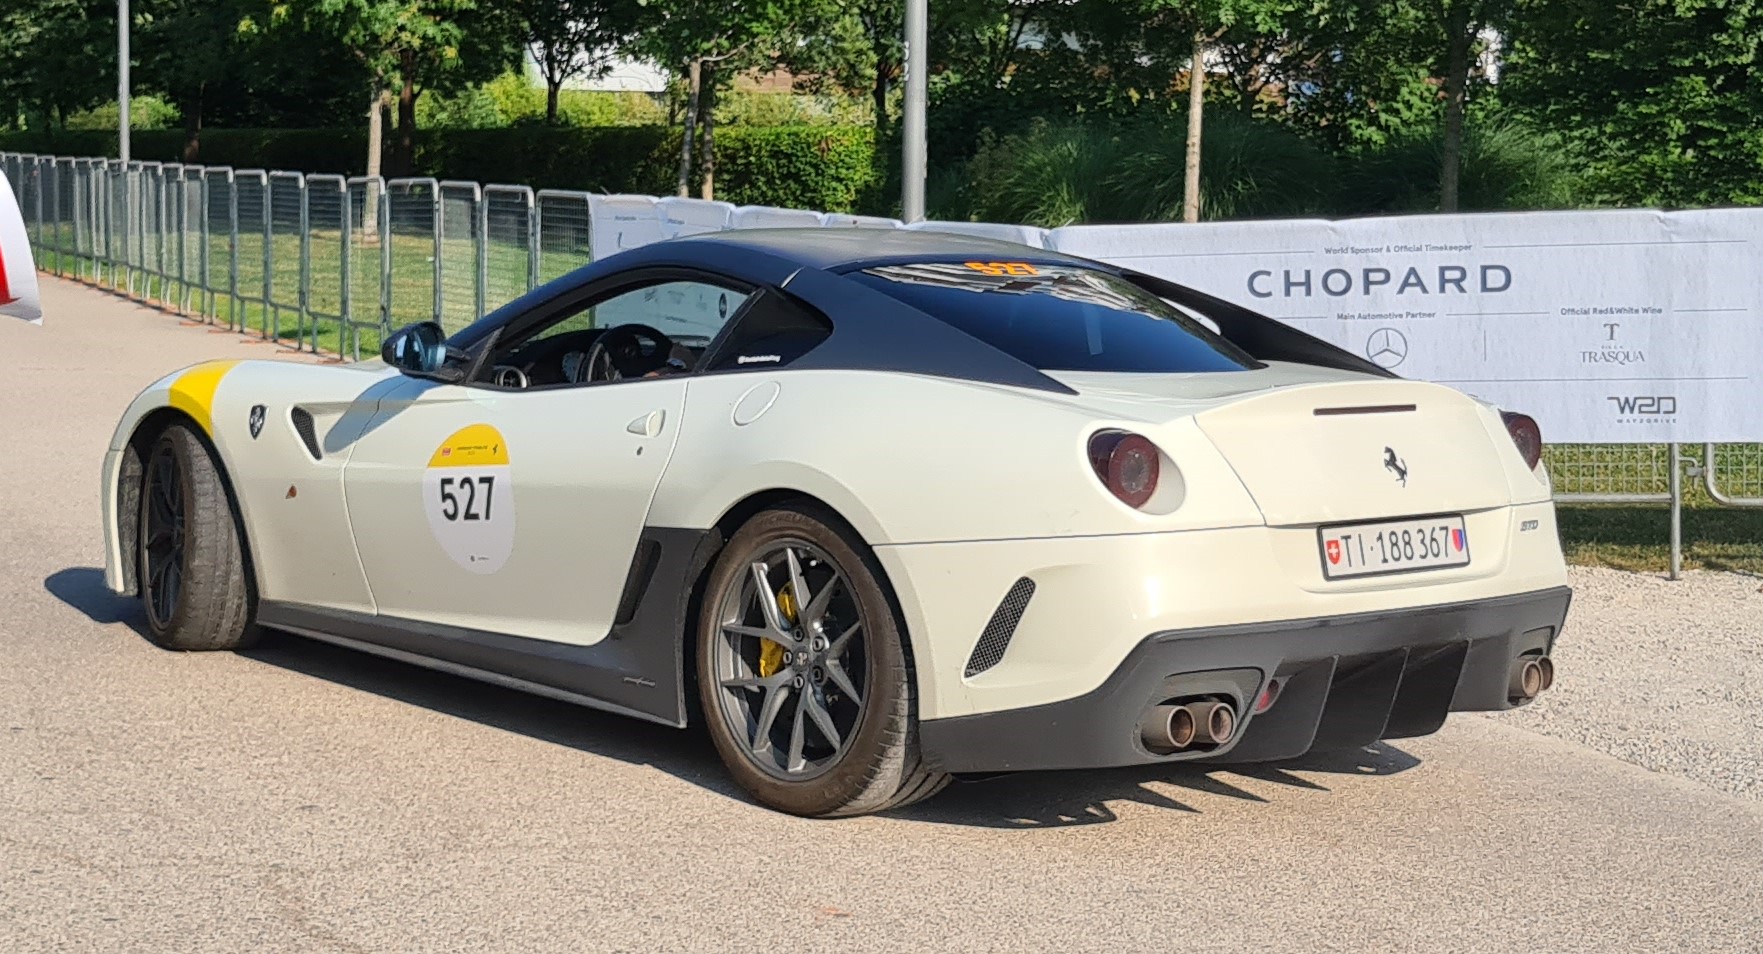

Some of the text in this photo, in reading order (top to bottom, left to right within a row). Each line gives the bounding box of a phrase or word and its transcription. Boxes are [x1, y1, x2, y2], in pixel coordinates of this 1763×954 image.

[1324, 246, 1349, 254] World
[1351, 246, 1383, 255] Sponsor
[1393, 244, 1423, 253] Official
[1424, 243, 1473, 253] Timekeeper
[1247, 264, 1513, 298] CHOPARD
[1336, 311, 1436, 320] Main Automotive Partner
[1592, 307, 1640, 315] Red&White
[1579, 351, 1645, 365] TRASQUA
[441, 476, 495, 521] 527
